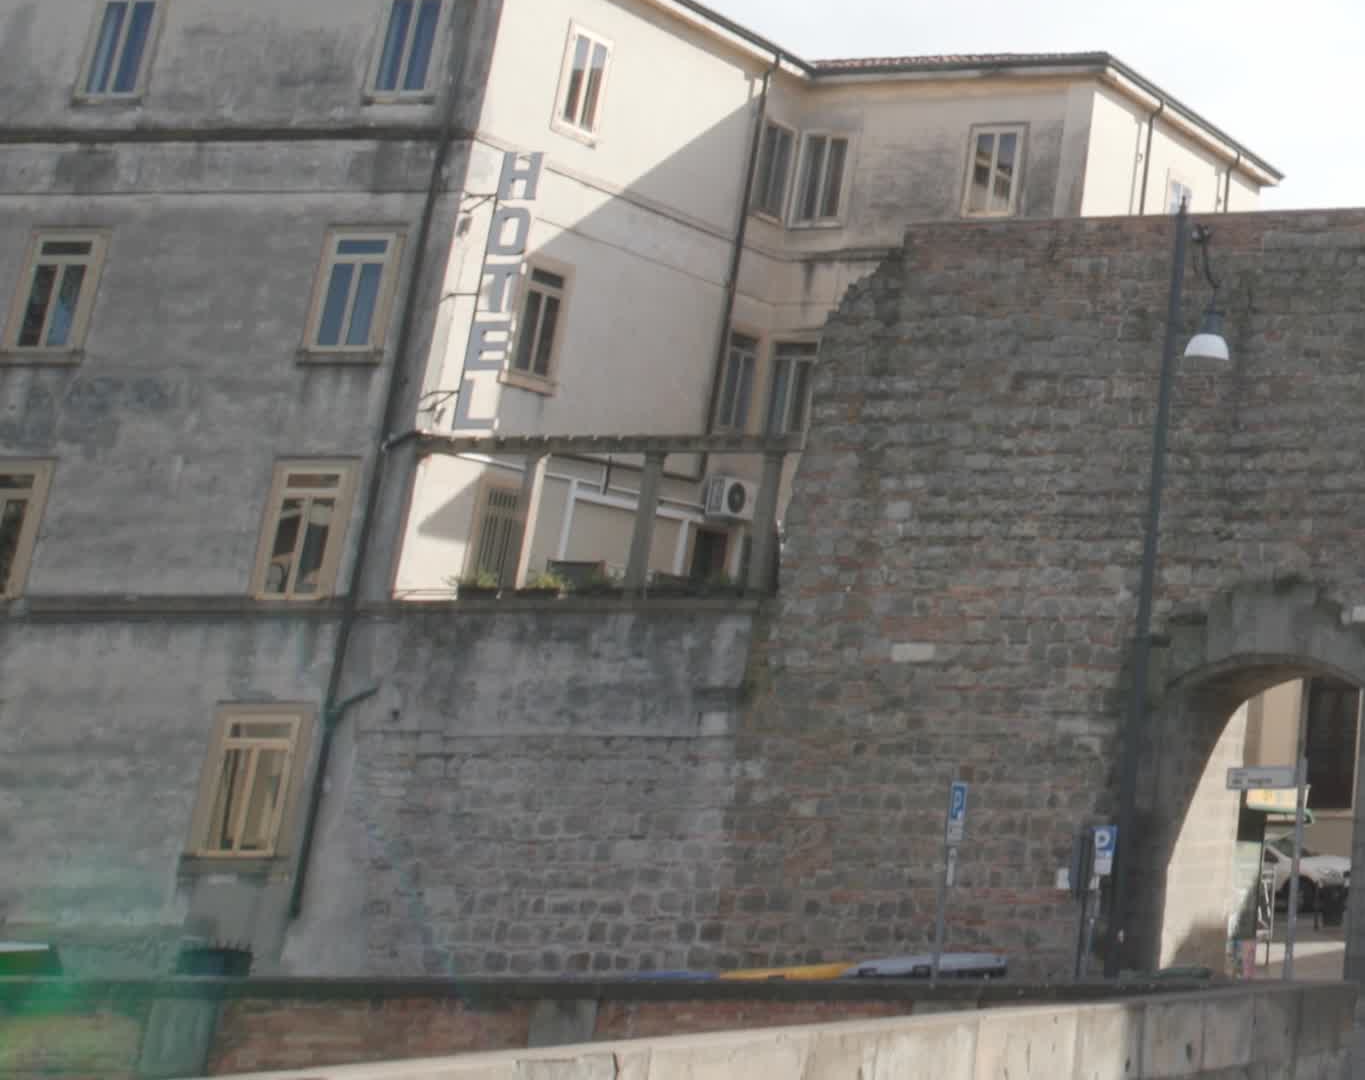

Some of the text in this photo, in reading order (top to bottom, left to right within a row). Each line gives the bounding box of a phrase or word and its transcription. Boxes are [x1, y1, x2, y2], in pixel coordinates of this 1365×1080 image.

[452, 151, 544, 431] HOTEL
[952, 791, 963, 817] P
[1094, 830, 1111, 852] P
